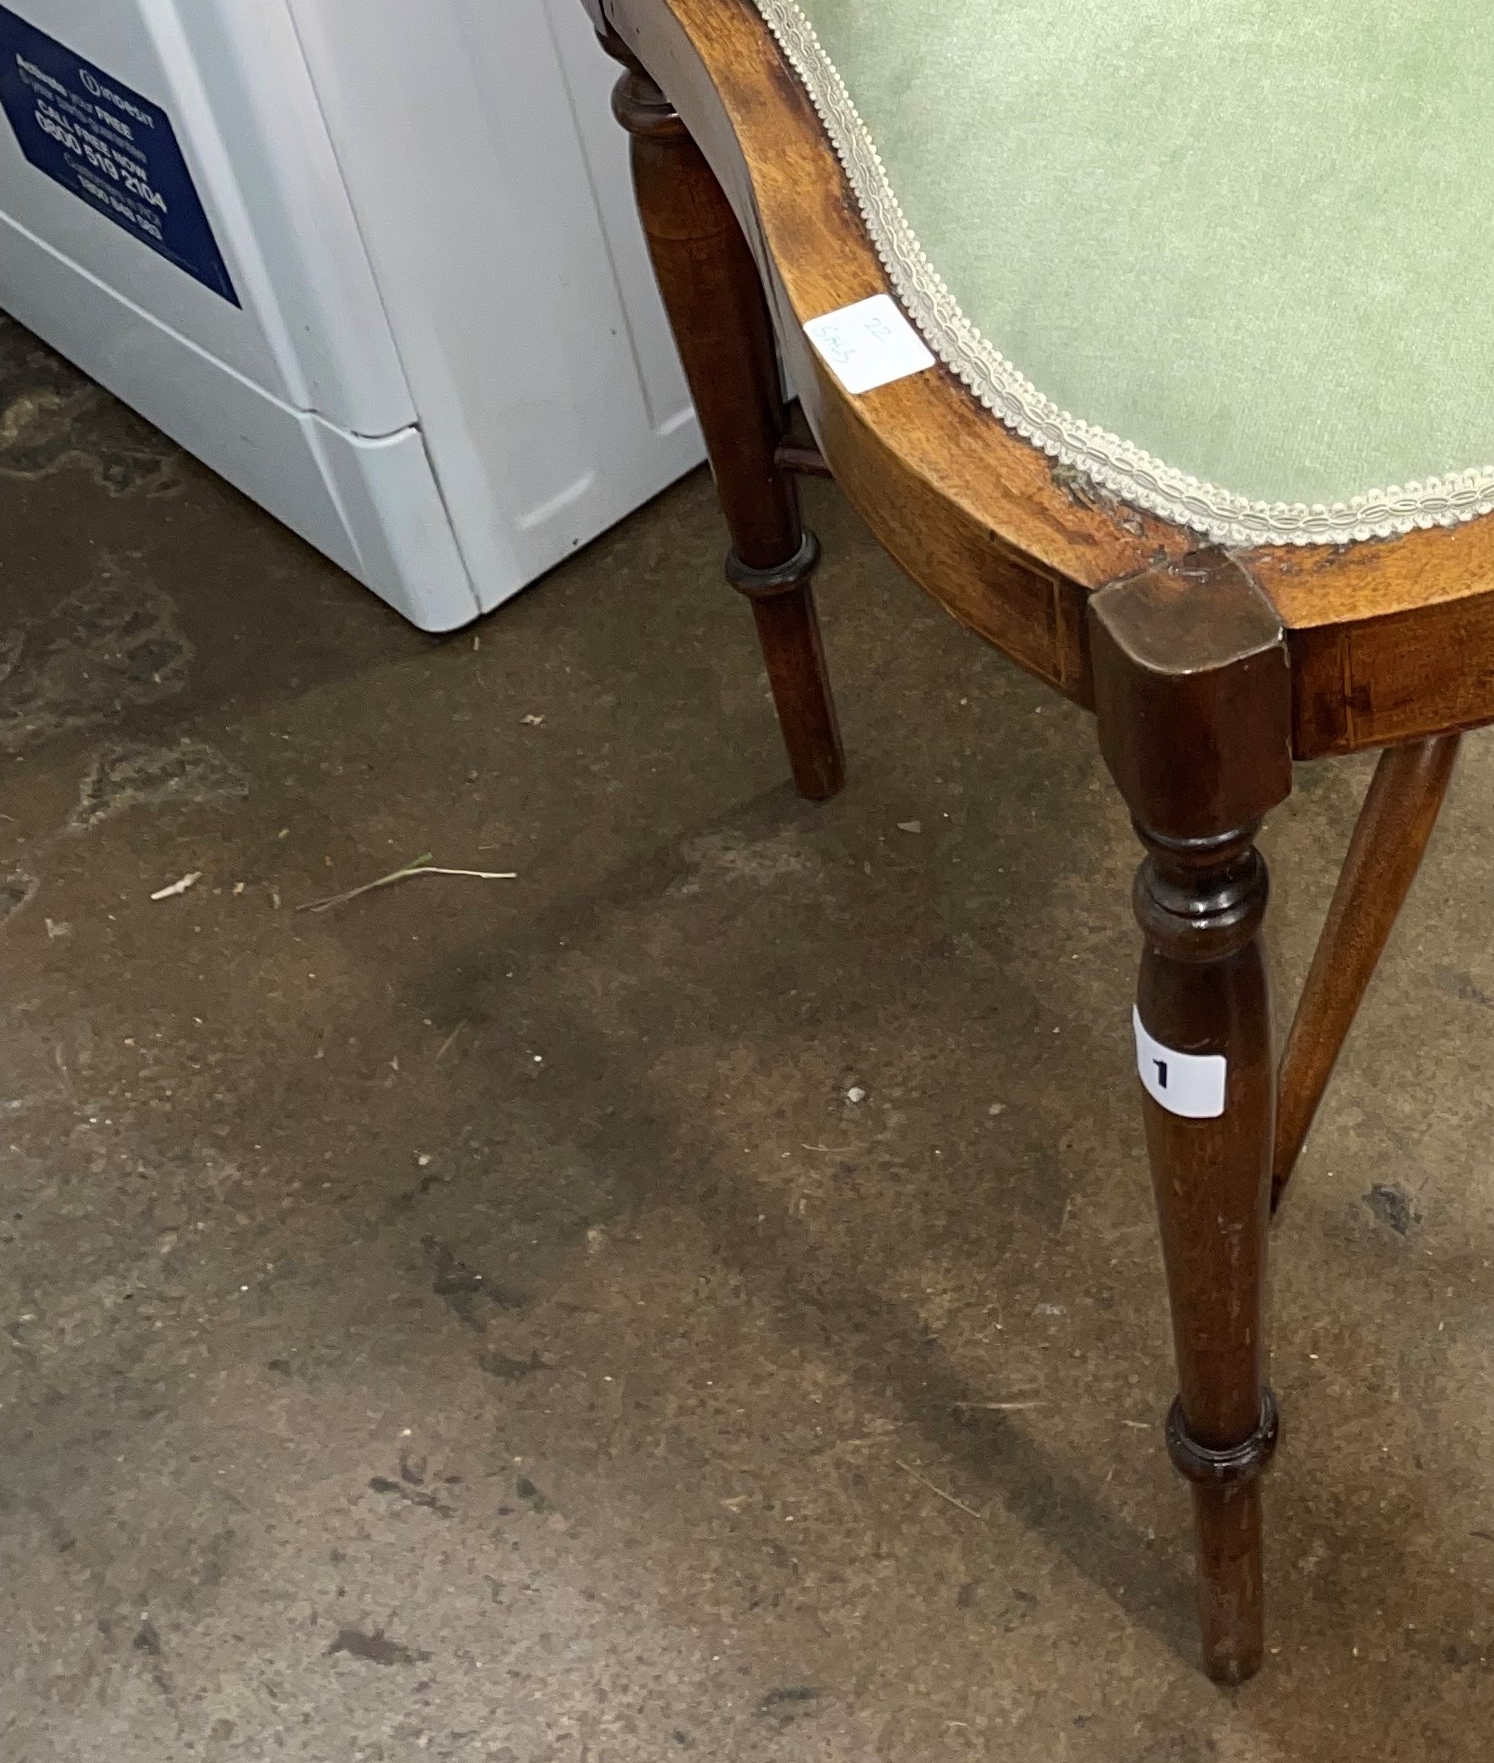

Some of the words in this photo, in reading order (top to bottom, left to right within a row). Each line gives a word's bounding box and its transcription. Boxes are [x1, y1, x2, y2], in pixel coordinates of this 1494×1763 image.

[36, 98, 74, 134] CALL
[73, 123, 112, 159] FREE
[111, 148, 147, 182] NOW
[94, 105, 134, 141] FREE
[82, 144, 119, 181] 519
[121, 169, 168, 214] 2104
[863, 317, 893, 342] 22
